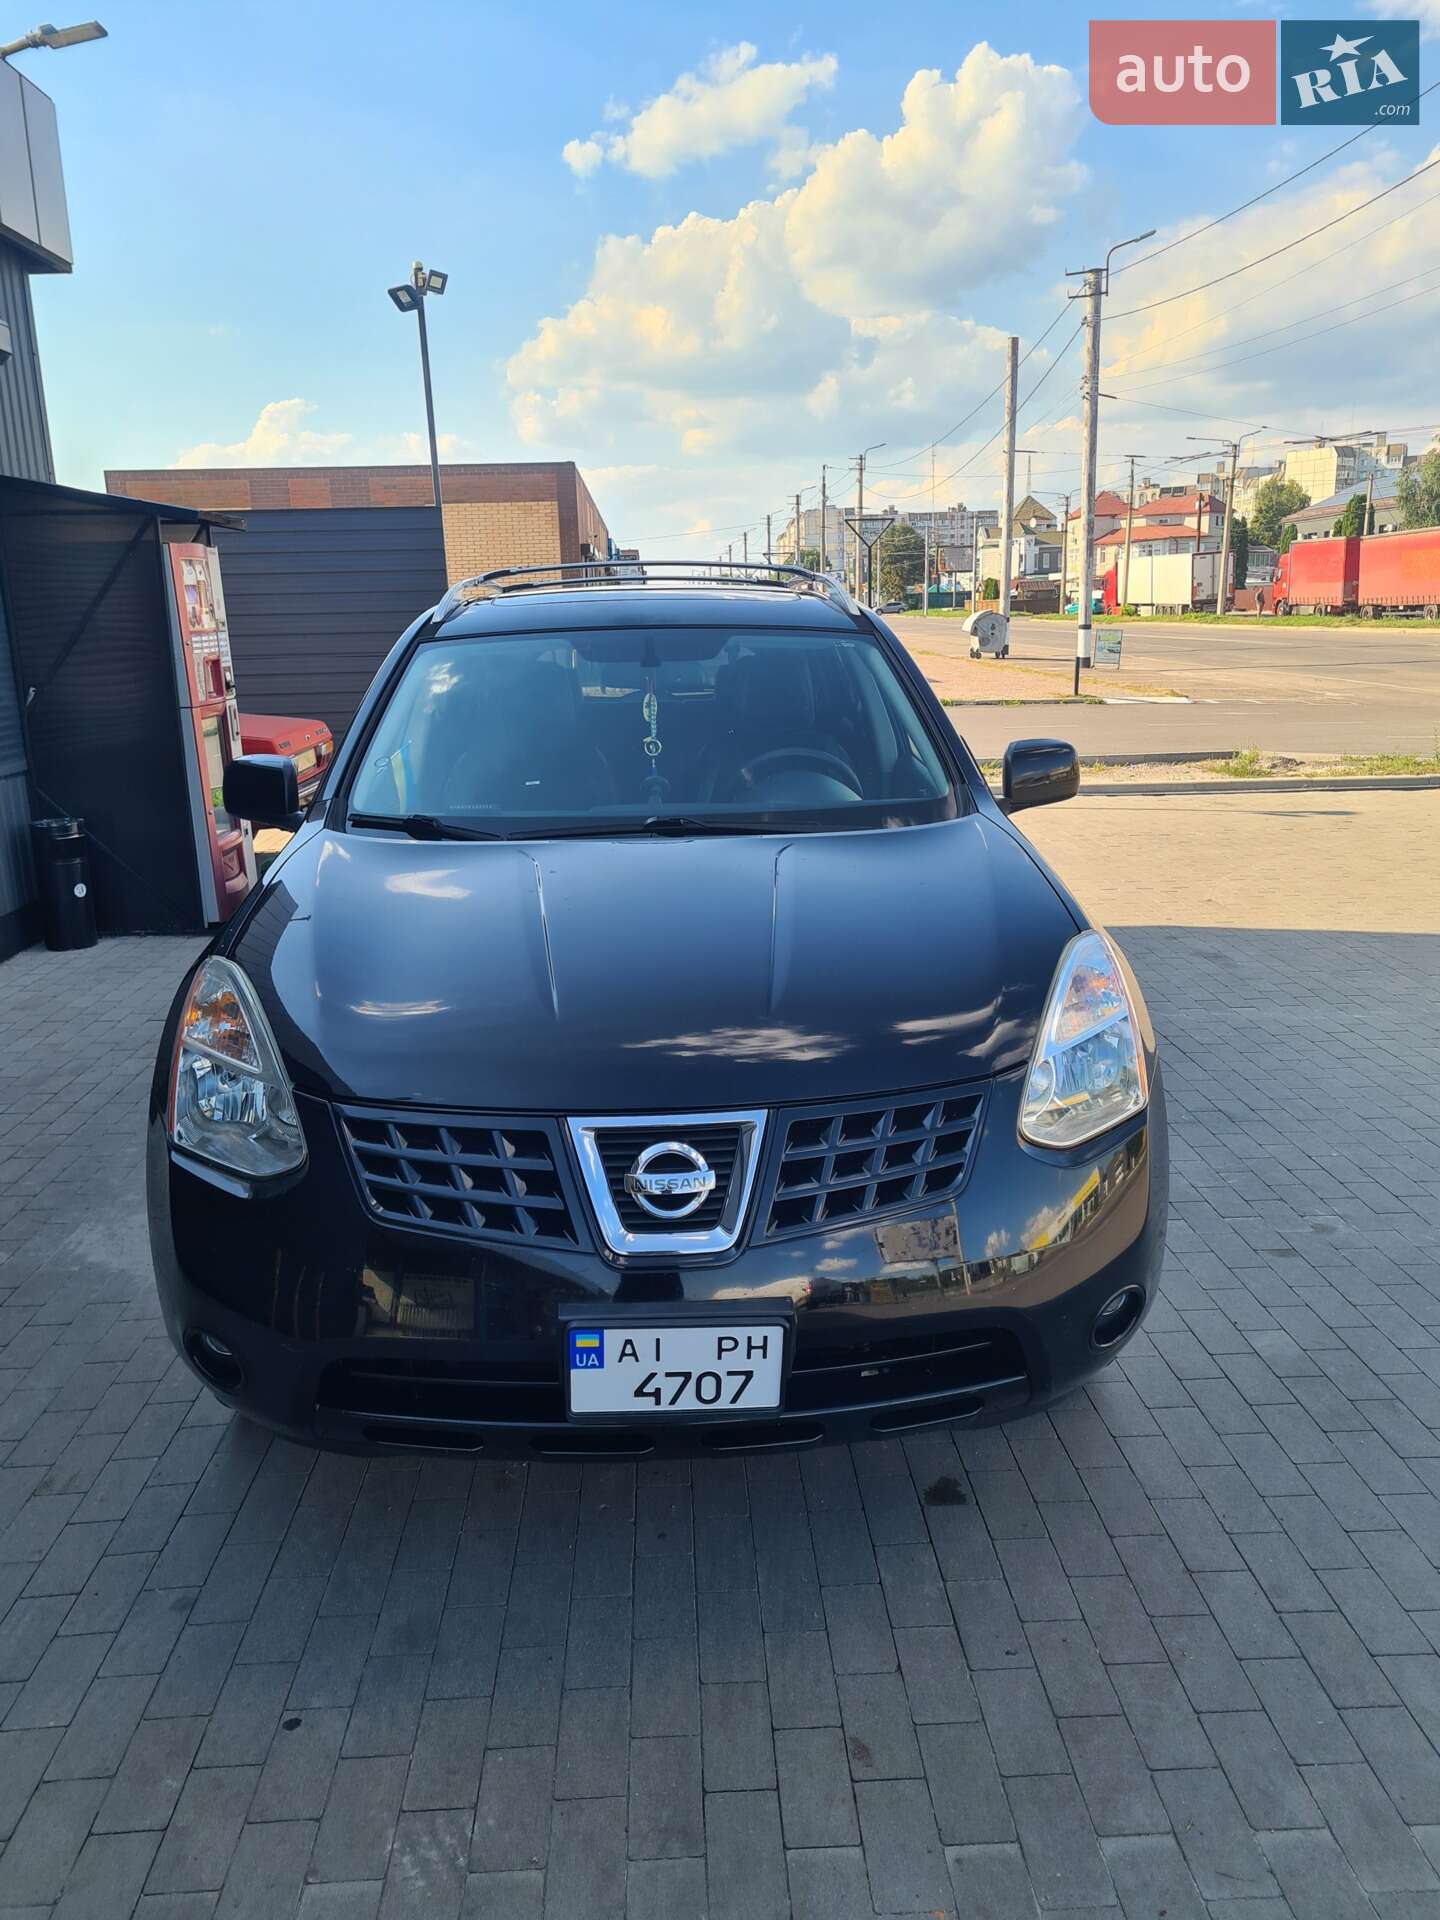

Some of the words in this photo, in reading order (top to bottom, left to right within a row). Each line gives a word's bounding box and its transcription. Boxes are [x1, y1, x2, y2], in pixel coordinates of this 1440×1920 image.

[634, 1175, 707, 1193] NISSAN
[717, 1335, 769, 1361] PH
[575, 1353, 600, 1367] UA
[633, 1370, 754, 1406] 4707
